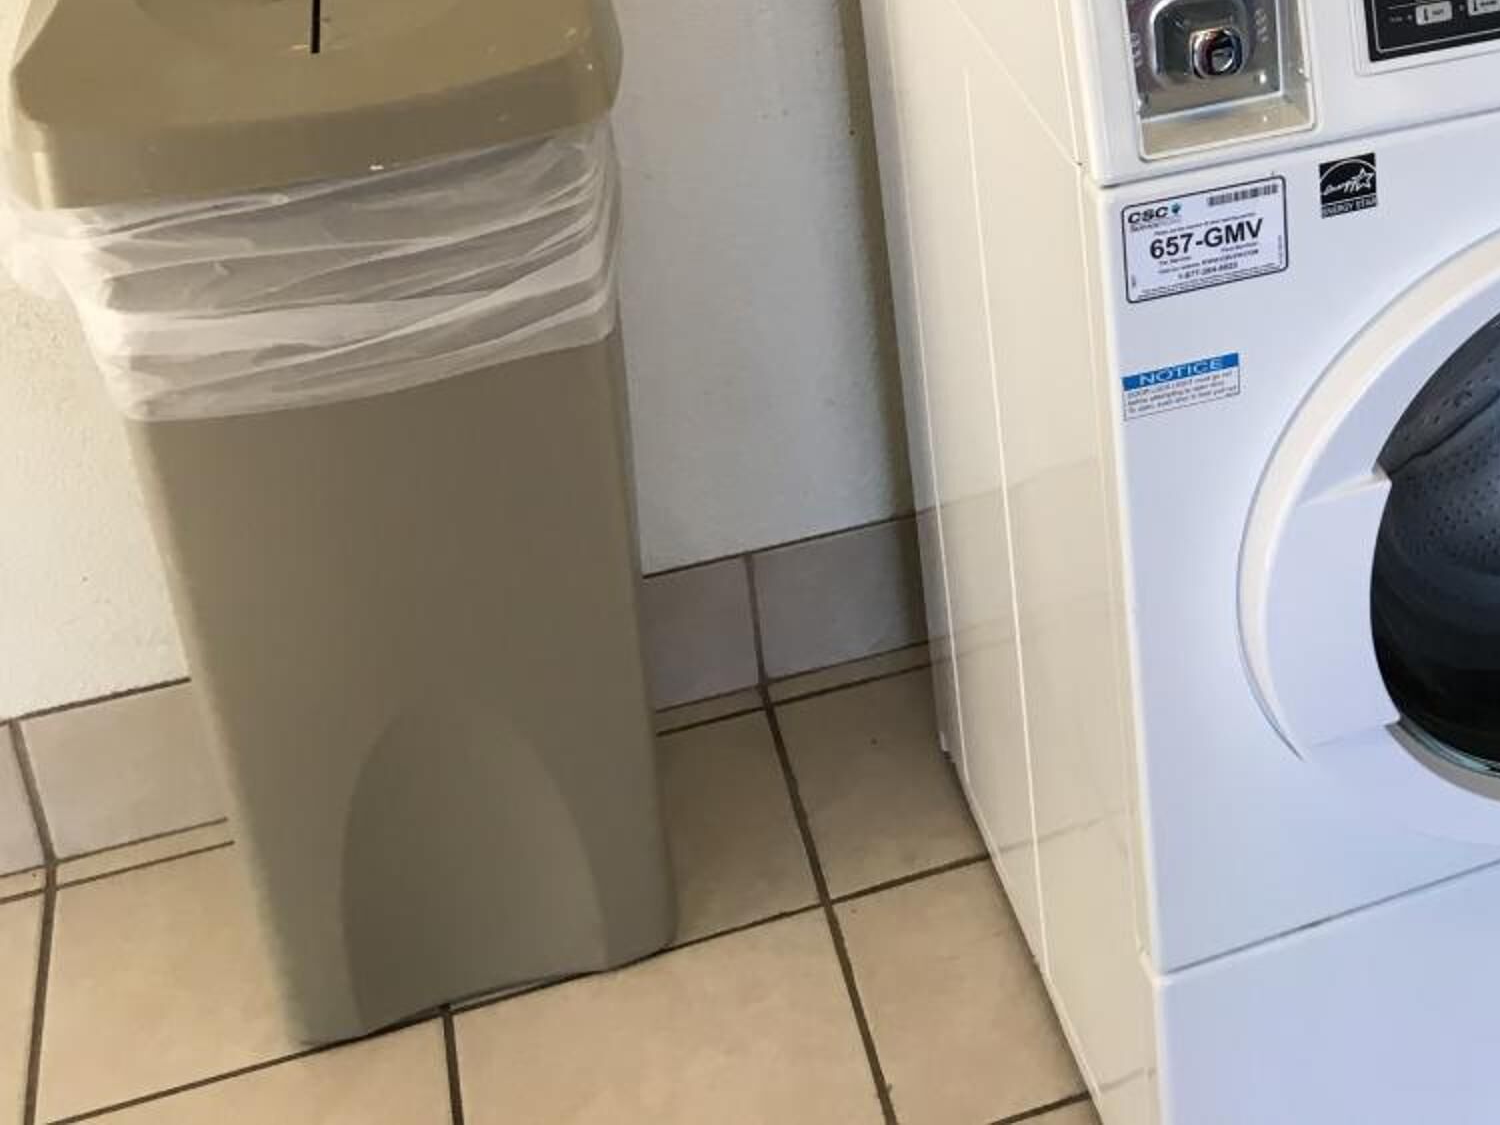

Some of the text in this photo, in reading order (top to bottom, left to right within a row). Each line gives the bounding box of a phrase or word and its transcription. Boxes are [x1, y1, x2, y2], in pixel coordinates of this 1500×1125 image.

[1127, 206, 1169, 225] CSC
[1150, 218, 1263, 259] 657-GMV
[1140, 359, 1222, 386] NOTICE
